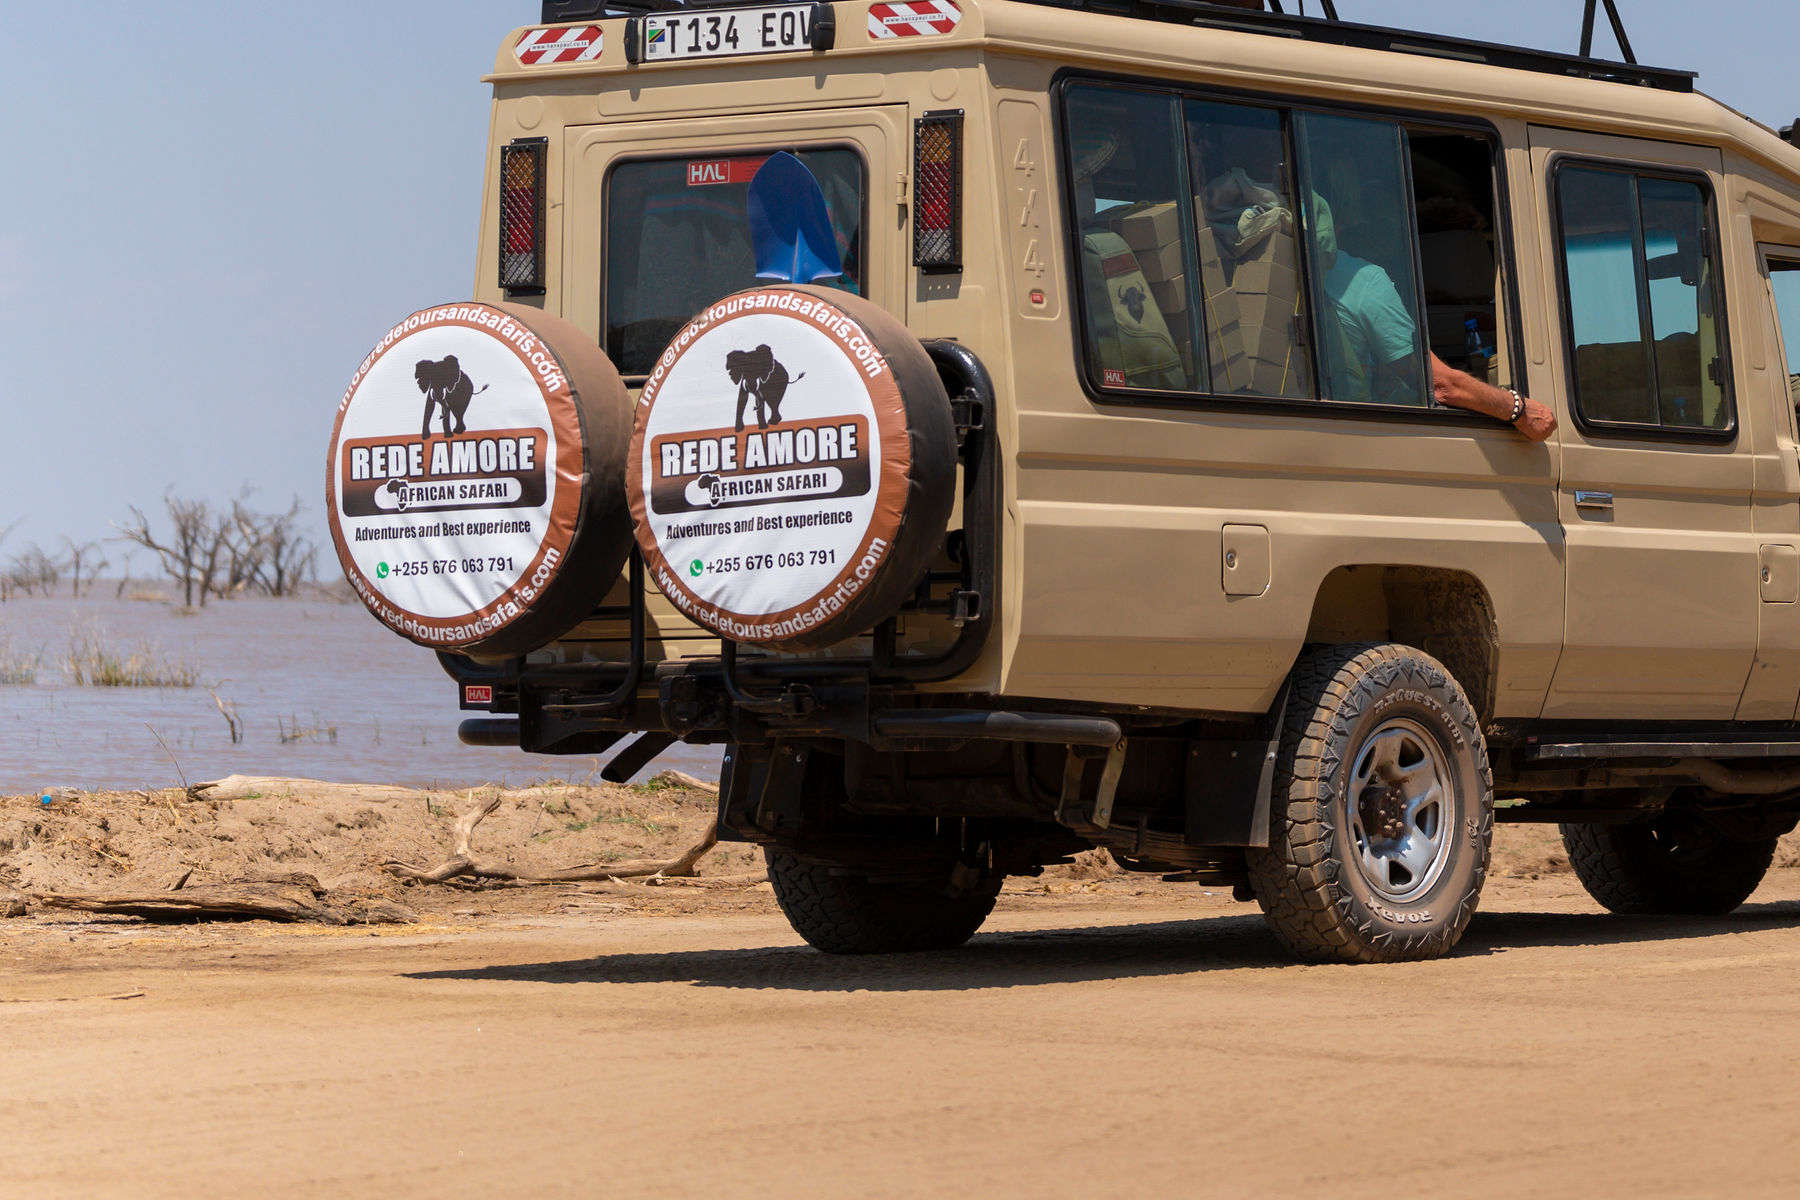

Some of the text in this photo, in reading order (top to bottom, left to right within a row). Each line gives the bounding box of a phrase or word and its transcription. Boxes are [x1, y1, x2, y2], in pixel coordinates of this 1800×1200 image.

[691, 163, 725, 182] HAL
[351, 437, 536, 480] REDE AMORE
[661, 424, 858, 477] REDE AMORE
[399, 483, 508, 502] AFRICAN SAFARI
[711, 473, 827, 498] AFRICAN SAFARI
[355, 519, 531, 541] Adventures and Best experience
[666, 510, 853, 539] Adventures and Best experience
[391, 556, 514, 576] +255 676 063 791
[706, 549, 836, 574] +255 676 063 791
[657, 537, 887, 639] www.redetoursandsafaris.com
[468, 689, 489, 700] HAL
